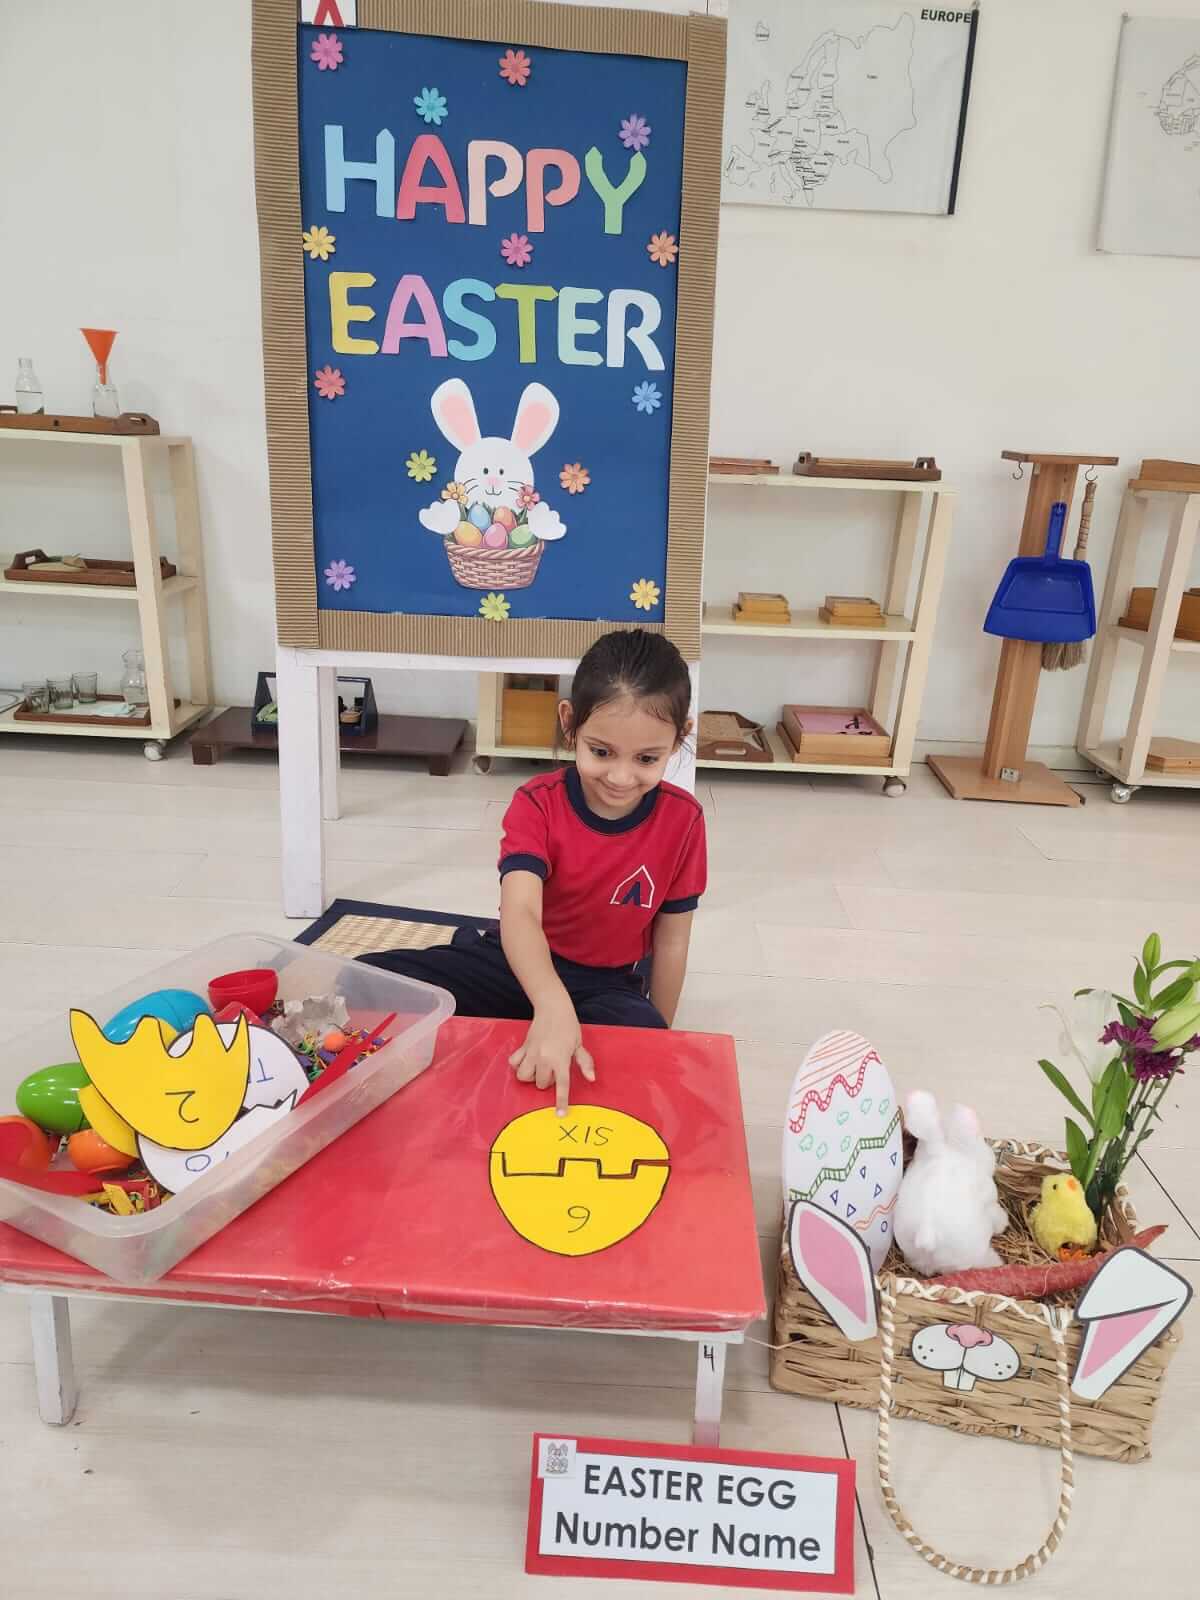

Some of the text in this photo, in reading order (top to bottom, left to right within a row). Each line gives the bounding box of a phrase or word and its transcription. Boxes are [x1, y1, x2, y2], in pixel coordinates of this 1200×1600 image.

[920, 9, 972, 24] EUROPE
[324, 124, 647, 235] HAPPY
[328, 271, 666, 371] EASTER
[703, 1344, 714, 1371] 4
[584, 1464, 798, 1511] EASTER EGG
[555, 1511, 821, 1562] Number Name
